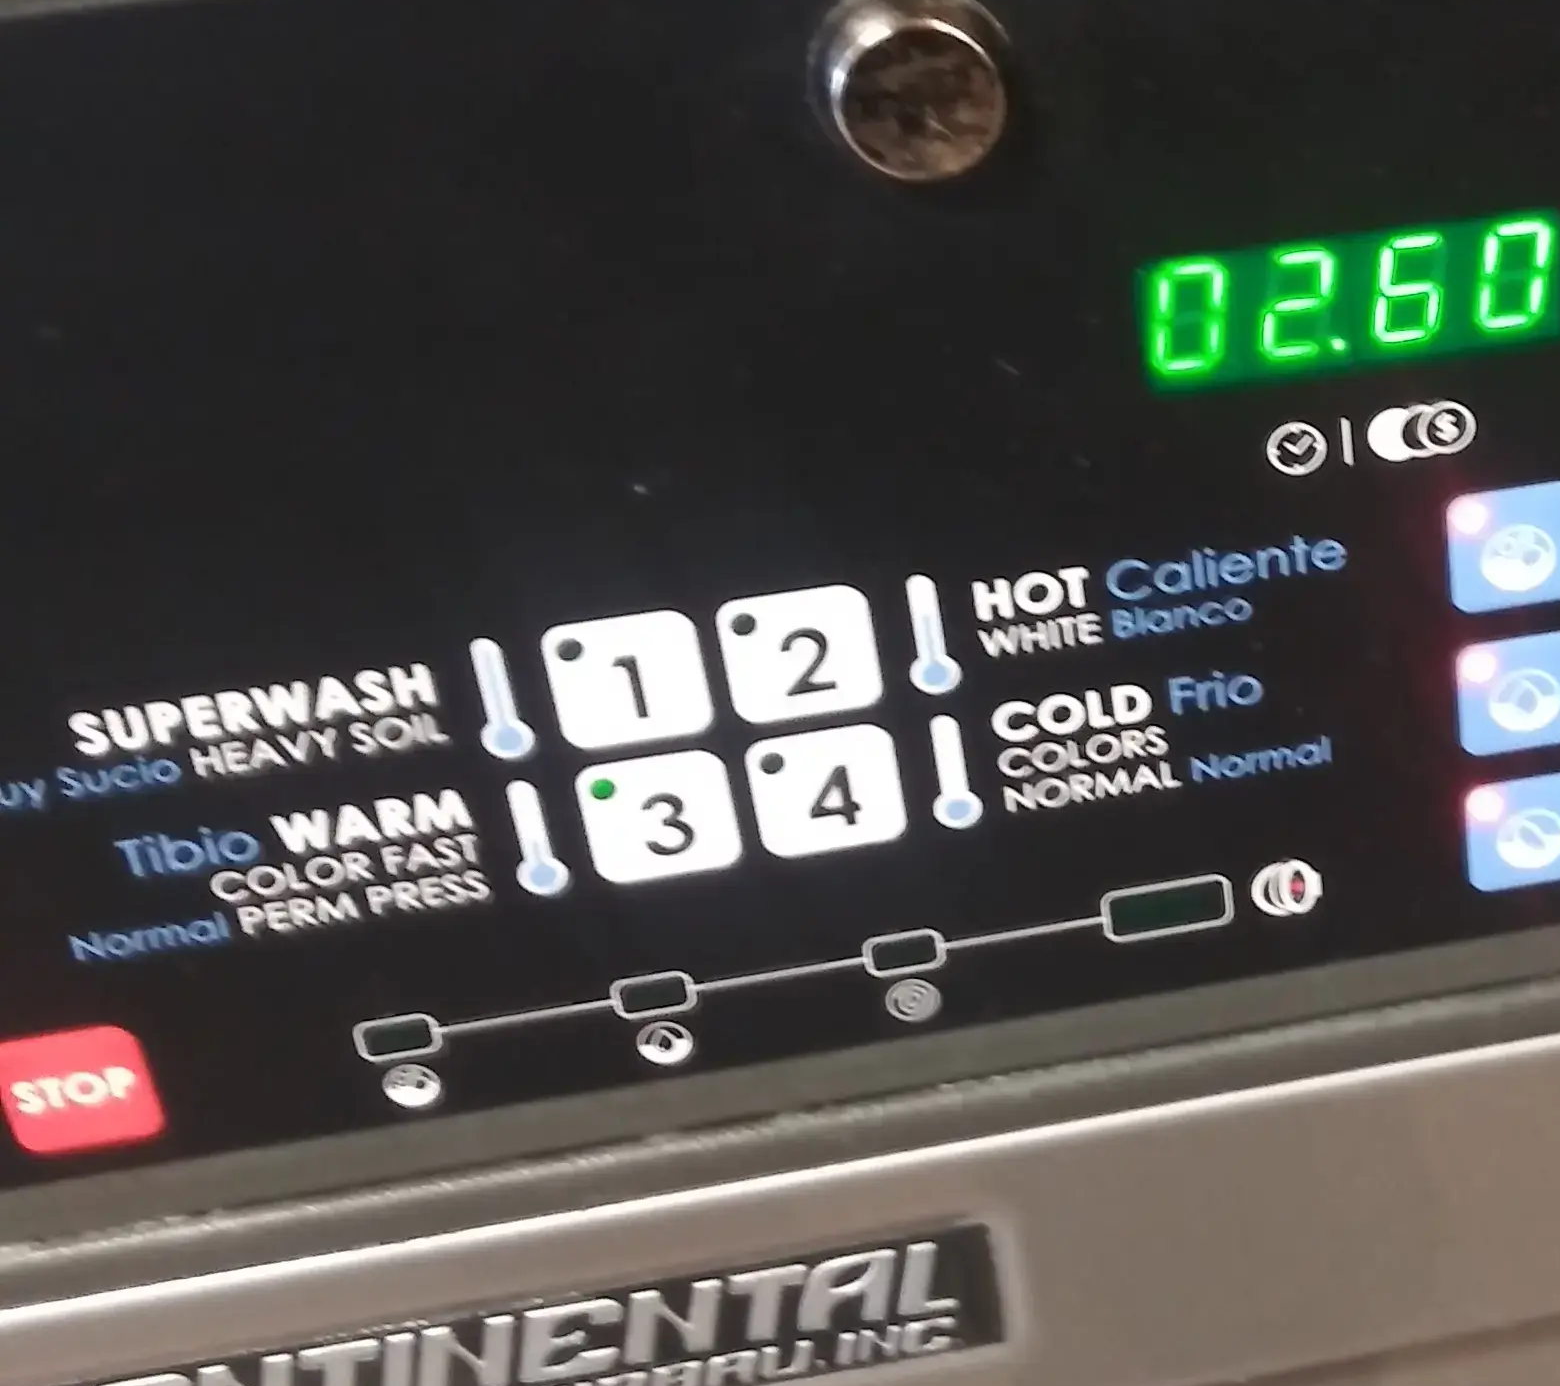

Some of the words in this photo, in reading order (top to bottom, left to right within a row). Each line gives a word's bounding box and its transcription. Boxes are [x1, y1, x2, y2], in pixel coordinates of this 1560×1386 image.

[1150, 218, 1555, 375] 02.60
[971, 565, 1091, 622] HOT
[1106, 533, 1348, 601] Caliente
[779, 626, 838, 698] 2
[976, 613, 1104, 658] WHITE
[1110, 596, 1254, 639] Blanco
[68, 661, 441, 757] SUPERWASH
[611, 654, 651, 719] 1
[991, 683, 1154, 742] COLD
[56, 755, 183, 800] Sucio
[188, 727, 338, 778] HEAVY
[350, 713, 452, 757] SOIL
[996, 725, 1171, 779] COLORS
[1002, 760, 1183, 813] NORMAL
[1189, 735, 1334, 783] Normal
[641, 792, 696, 856] 3
[809, 764, 863, 826] 4
[113, 826, 261, 879] Tibio
[270, 787, 474, 855] WARM
[209, 851, 375, 904] COLOR
[381, 832, 481, 876] FAST
[68, 911, 234, 963] Normal
[236, 892, 361, 938] PERM
[365, 869, 494, 916] PRESS
[9, 1066, 137, 1115] STOP
